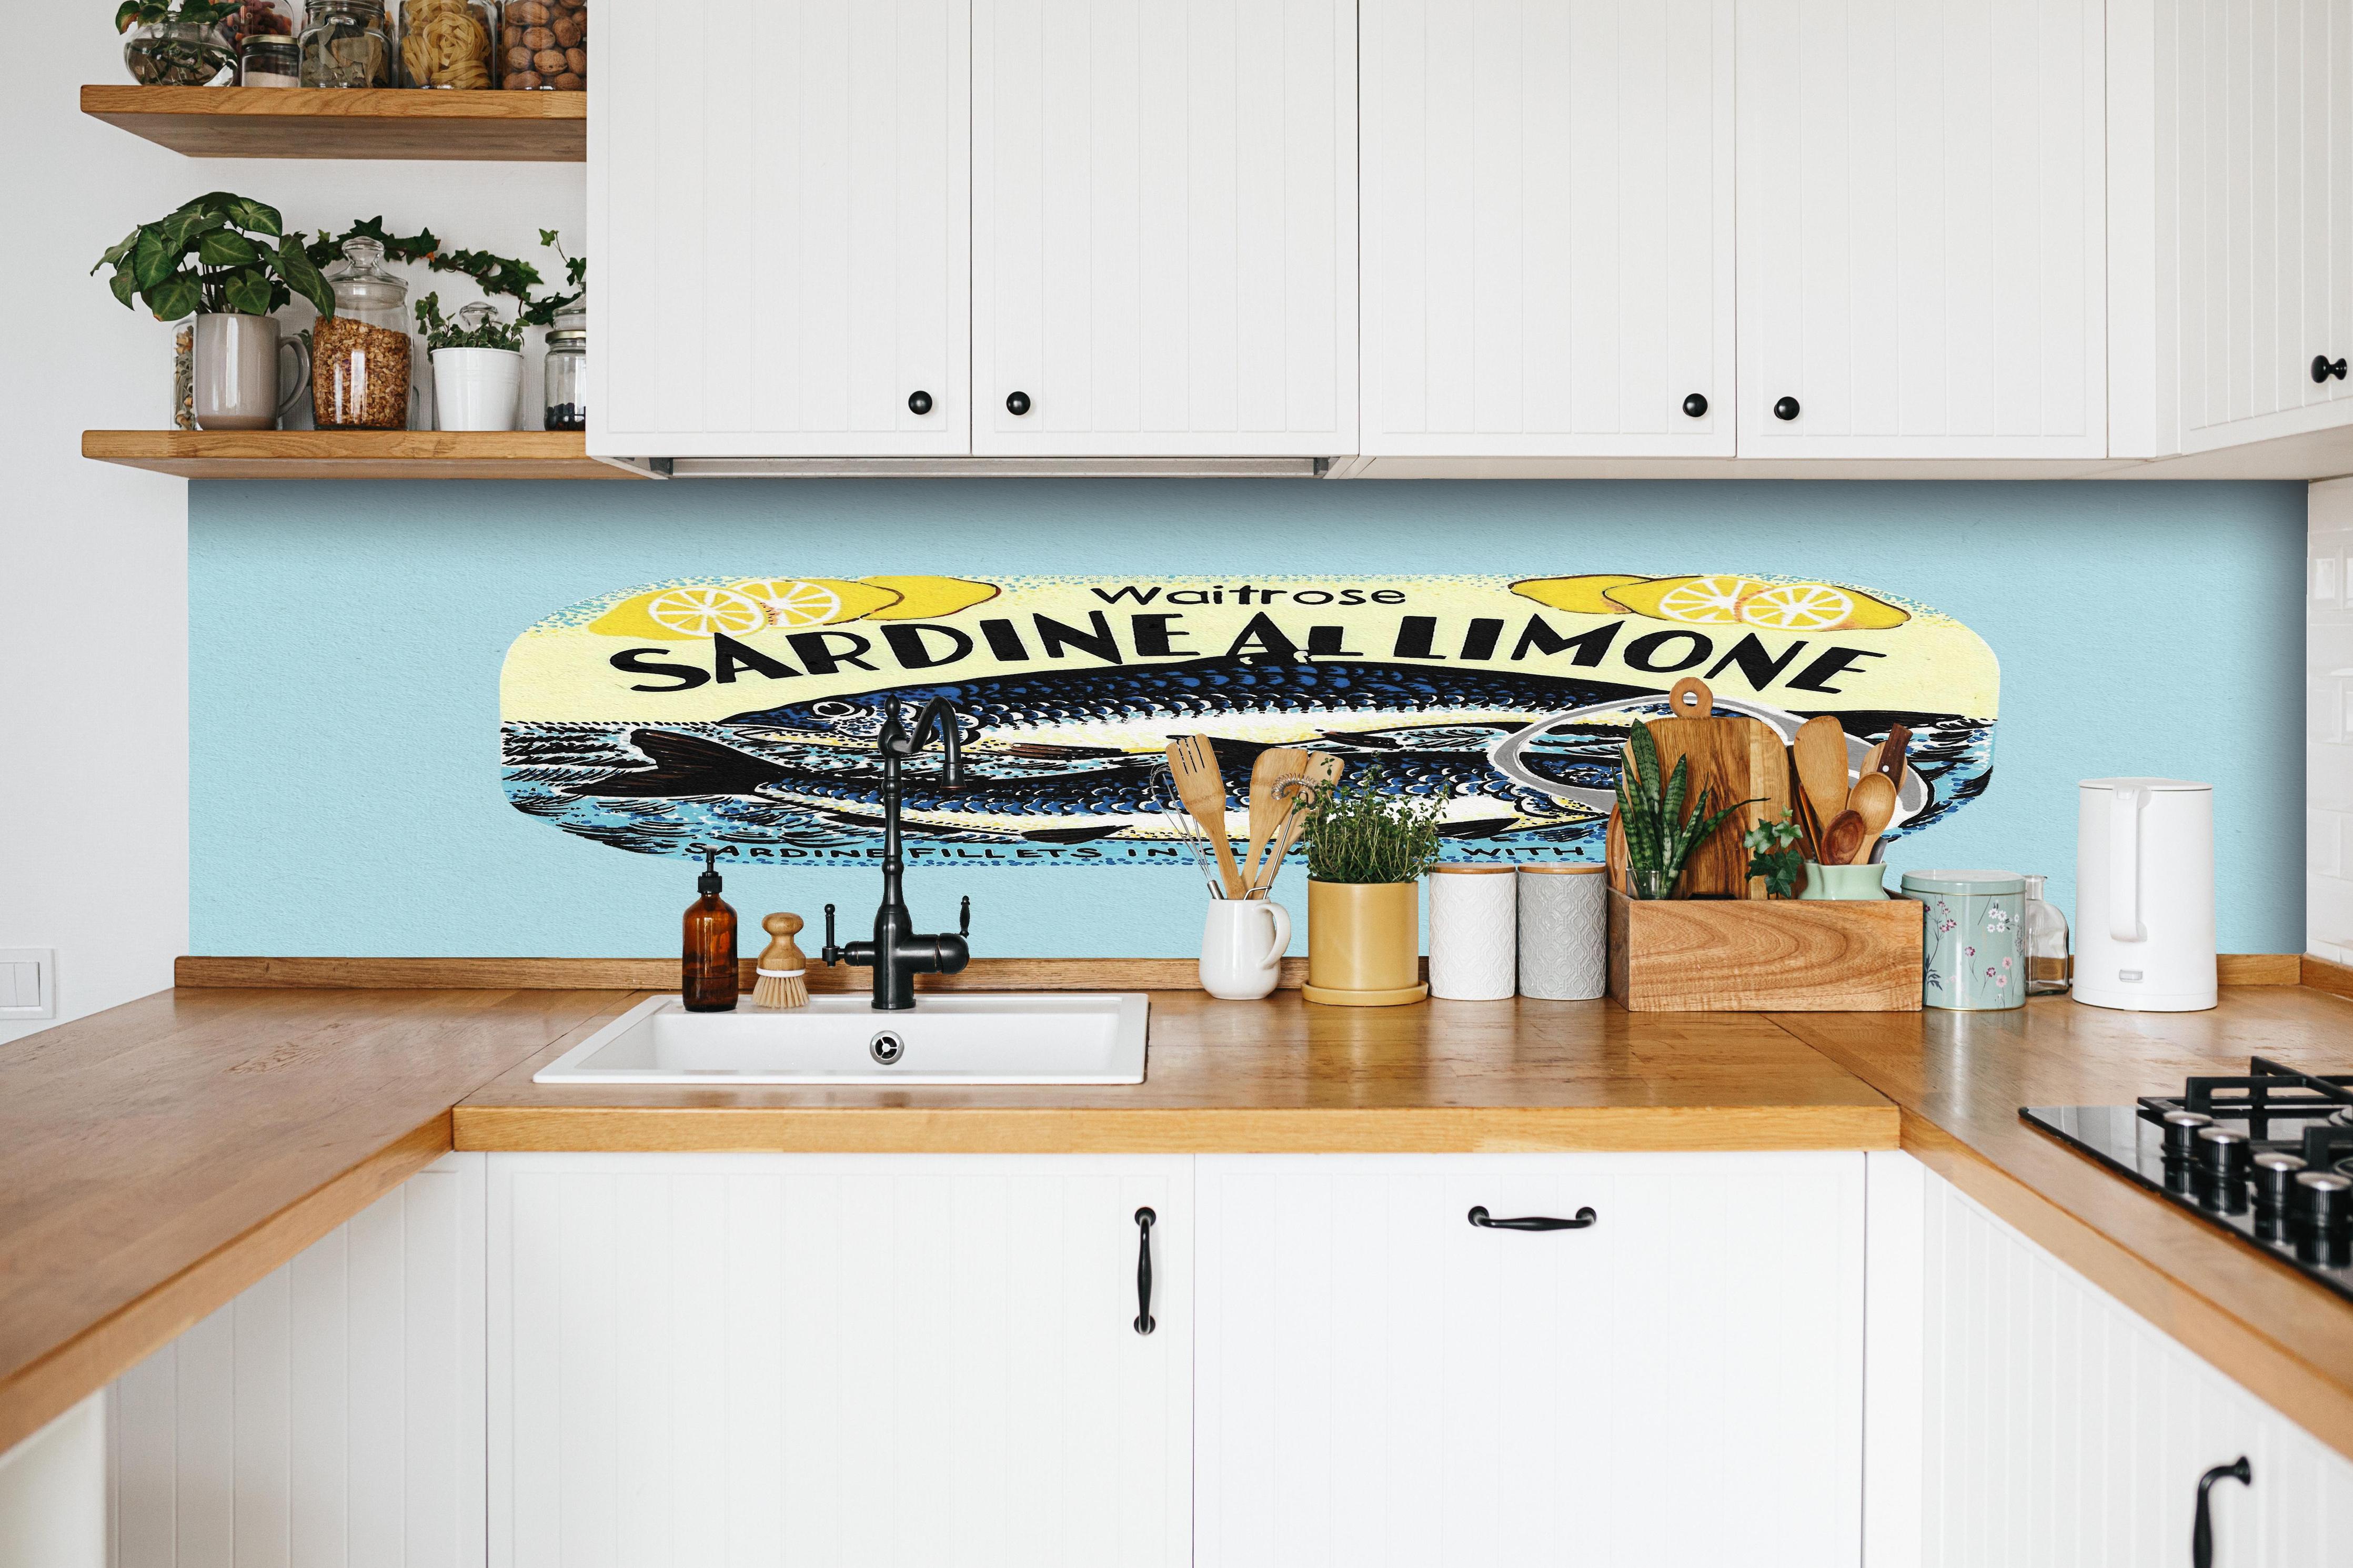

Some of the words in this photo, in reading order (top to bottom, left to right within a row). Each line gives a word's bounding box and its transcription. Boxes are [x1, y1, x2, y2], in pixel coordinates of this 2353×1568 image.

[1090, 584, 1406, 605] Waitrose
[609, 610, 1201, 693] SARDINE
[1225, 611, 1364, 657] AL
[1393, 613, 1888, 694] LIMONE
[907, 847, 1103, 858] FILLETS
[1128, 847, 1178, 857] IN
[1461, 846, 1585, 856] WITH
